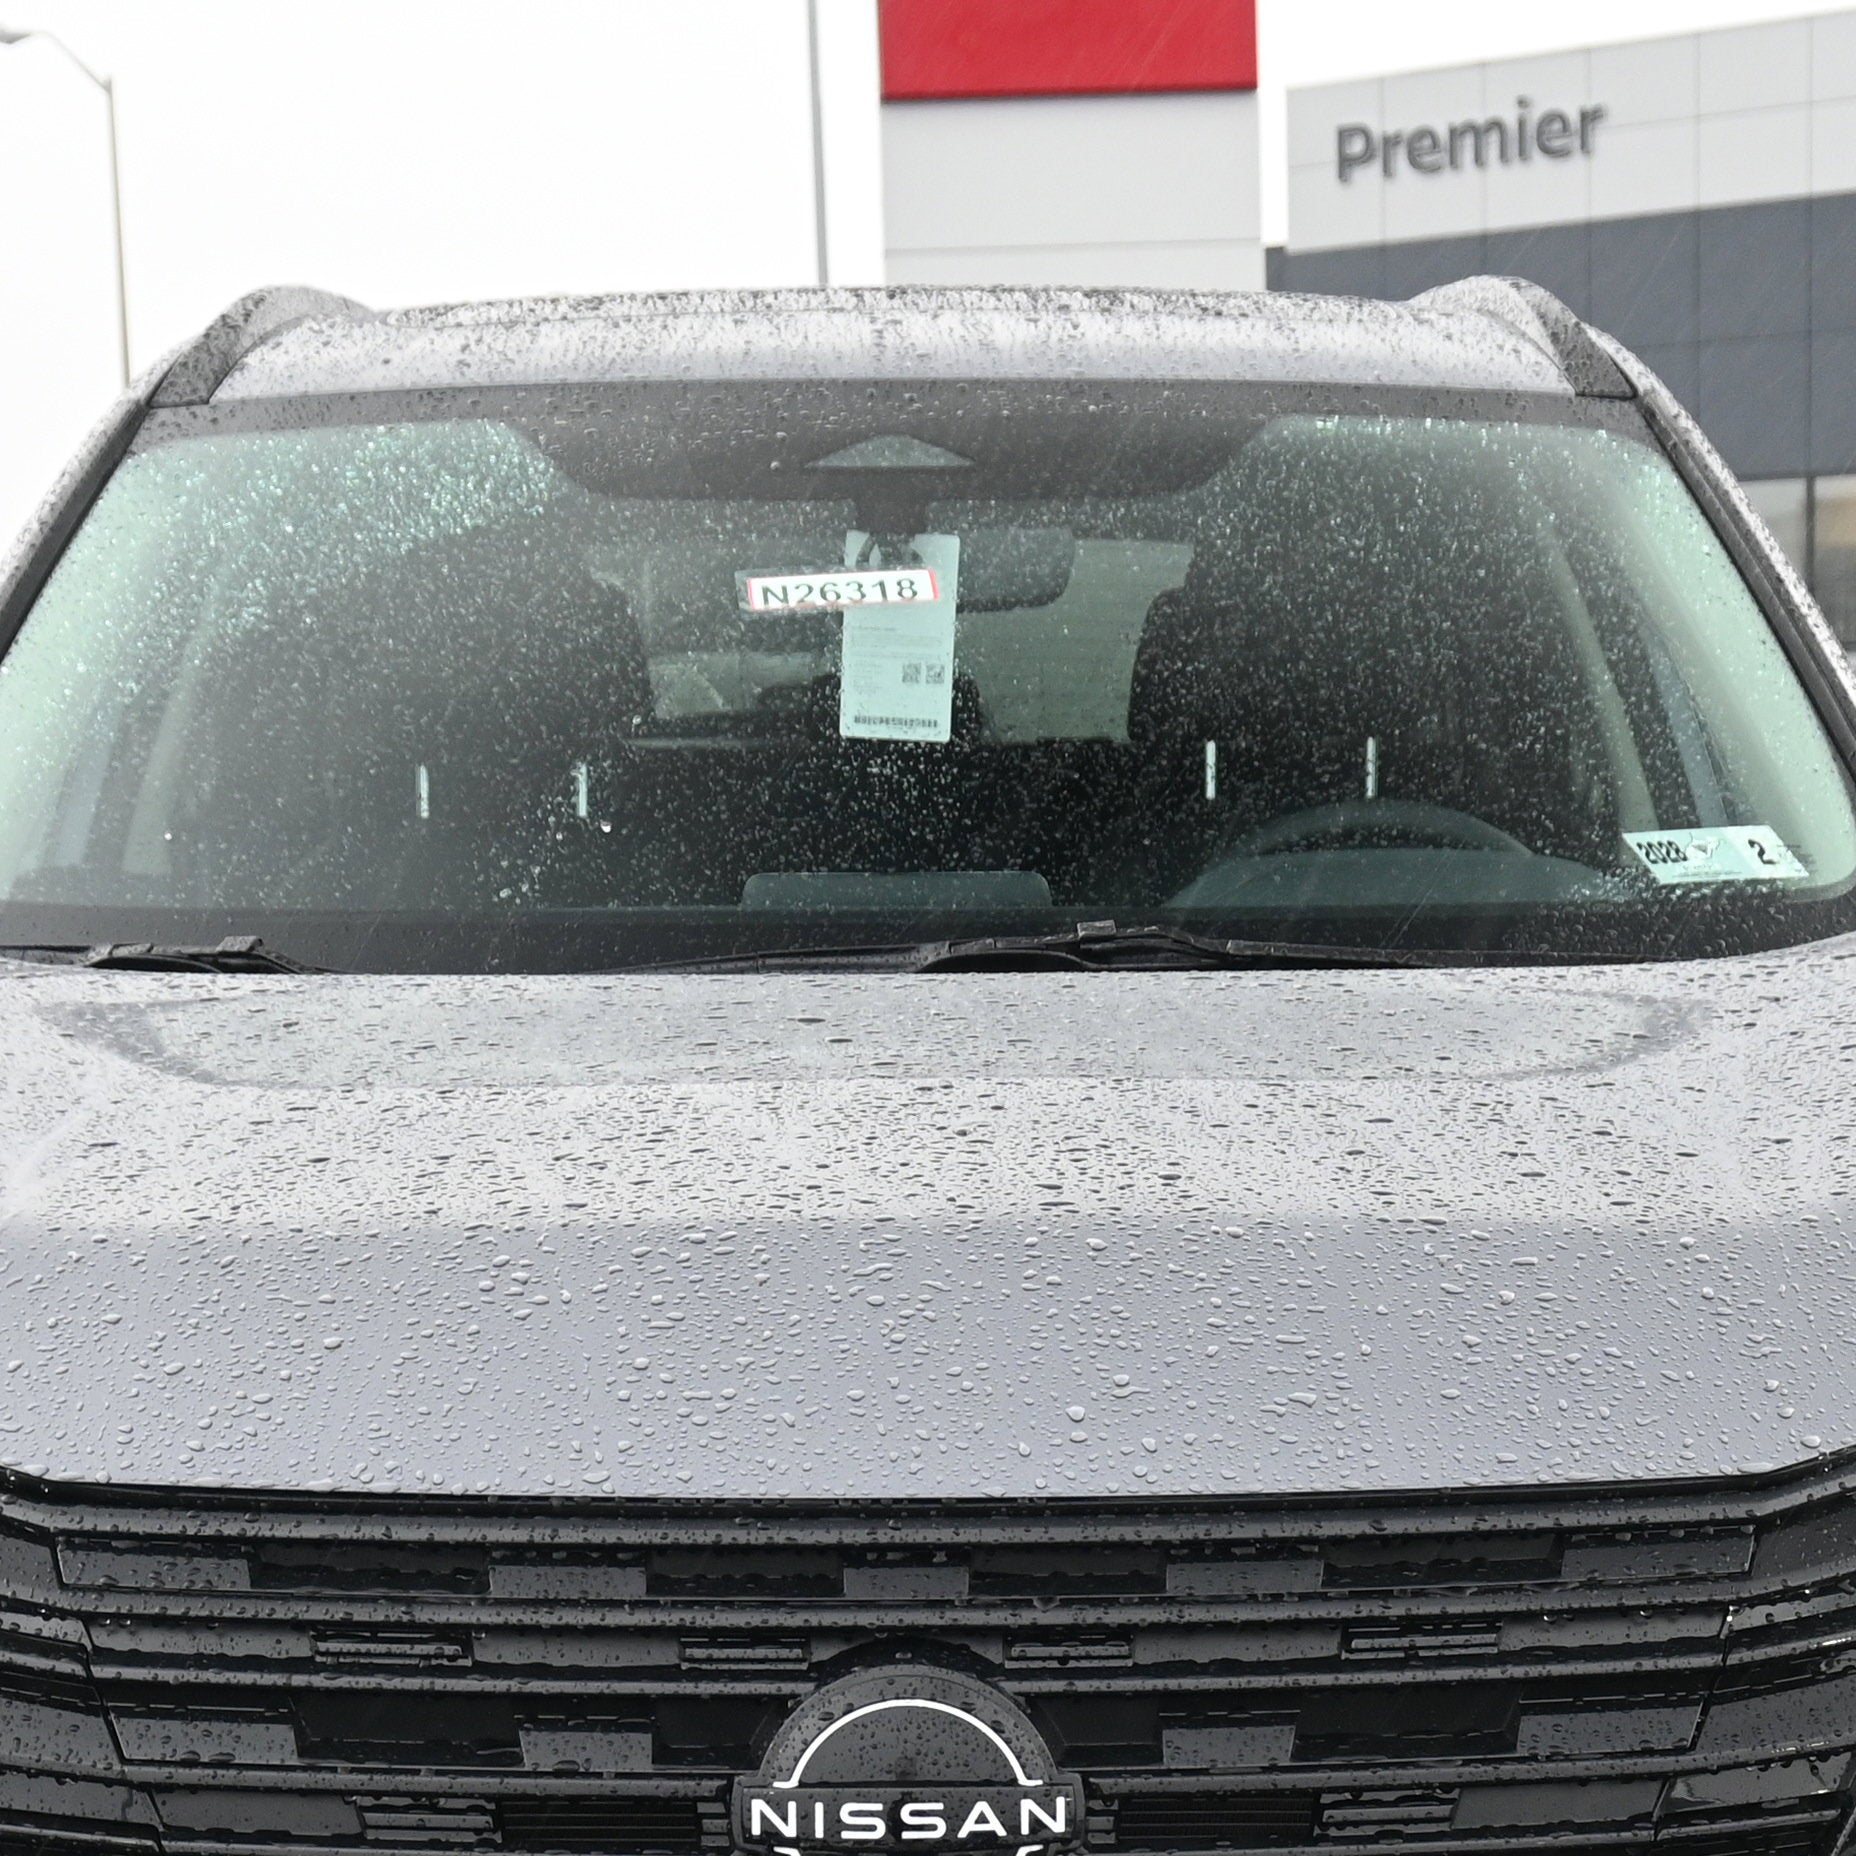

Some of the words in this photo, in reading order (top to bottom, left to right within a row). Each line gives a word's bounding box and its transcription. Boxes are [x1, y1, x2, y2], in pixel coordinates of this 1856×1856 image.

[1337, 94, 1608, 182] Premier
[761, 577, 918, 606] N26318
[1636, 839, 1688, 865] 2028
[1747, 838, 1778, 865] 2
[750, 1796, 1067, 1840] NISSAN
